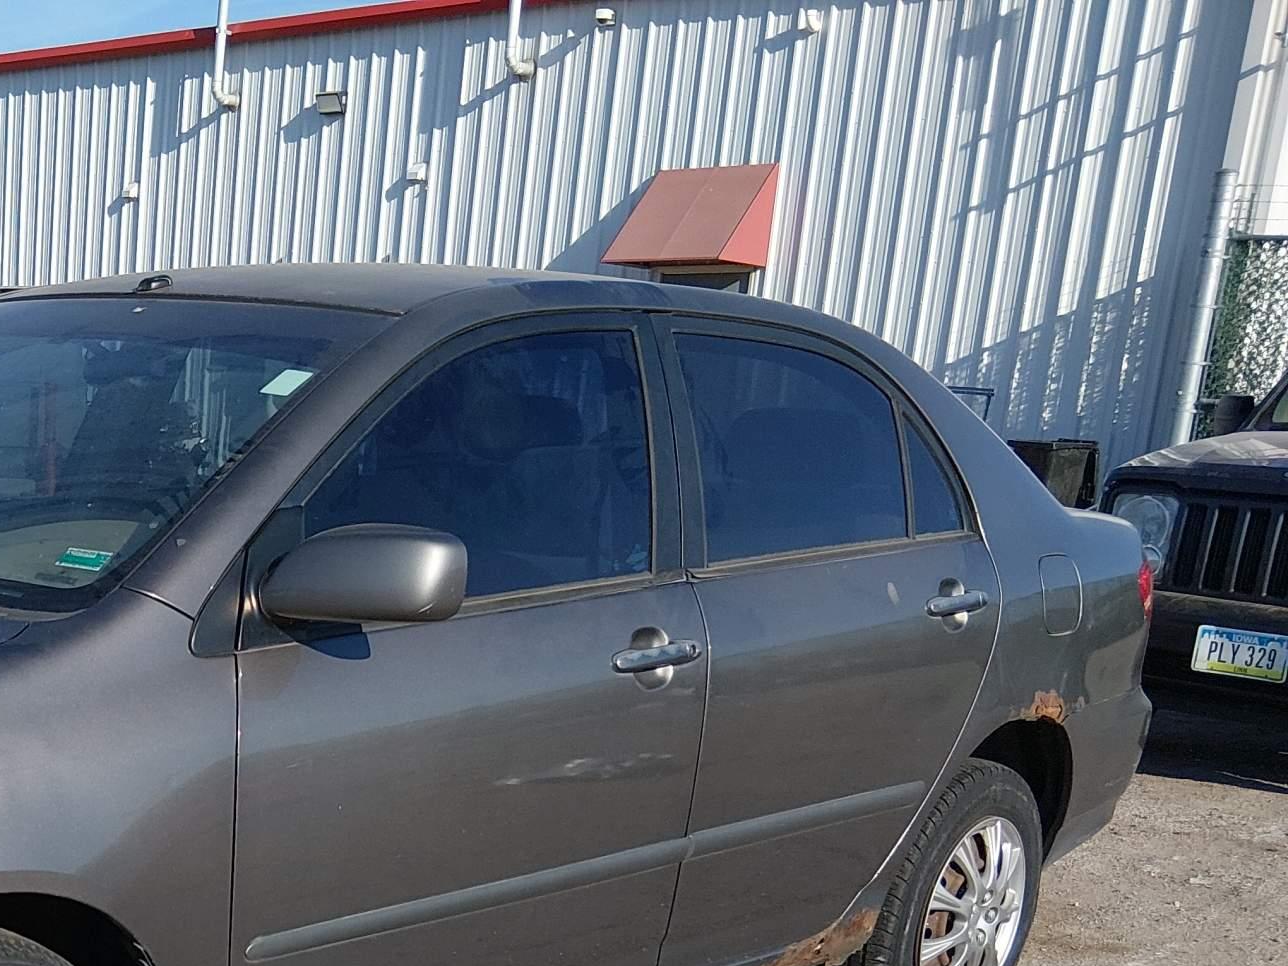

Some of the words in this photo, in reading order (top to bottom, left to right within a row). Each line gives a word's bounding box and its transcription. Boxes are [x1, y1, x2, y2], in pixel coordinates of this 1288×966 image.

[1232, 633, 1260, 645] IOWA
[1207, 641, 1241, 664] PLY
[1245, 645, 1277, 670] 329
